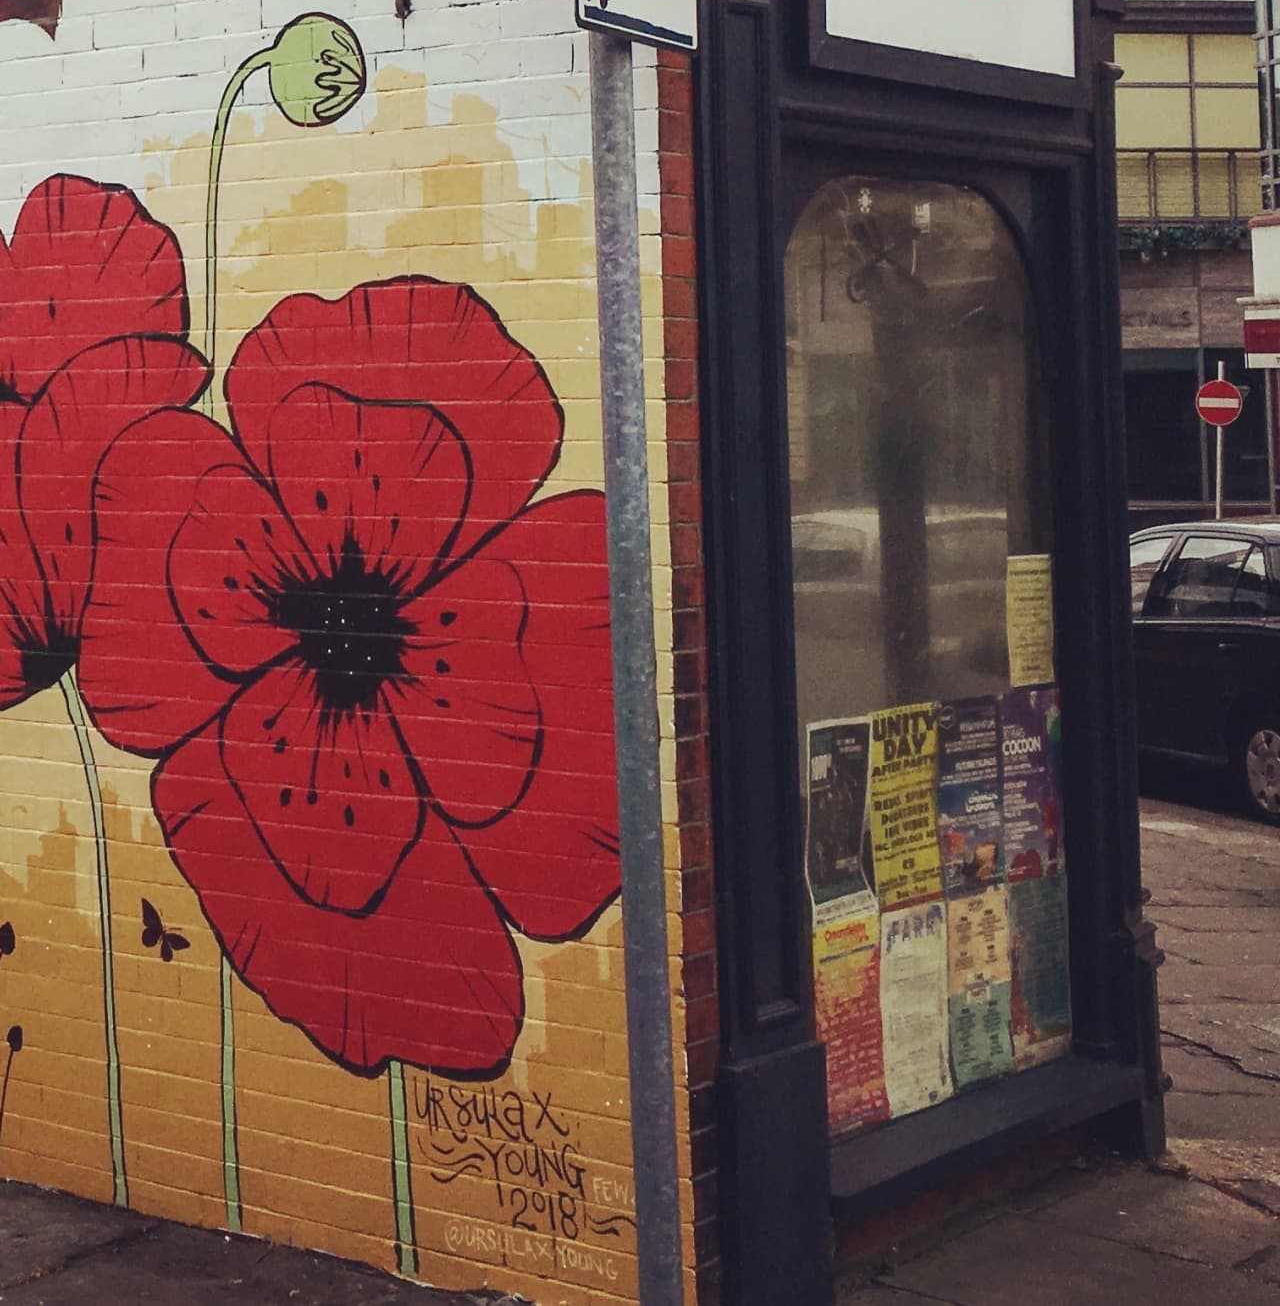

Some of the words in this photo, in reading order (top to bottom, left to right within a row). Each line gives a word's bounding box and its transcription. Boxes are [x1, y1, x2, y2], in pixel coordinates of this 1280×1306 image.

[873, 713, 936, 742] UNITY
[883, 733, 927, 762] DAY
[1002, 736, 1042, 756] COCOON
[474, 1137, 587, 1207] YOUNG
[509, 1188, 579, 1240] 2018
